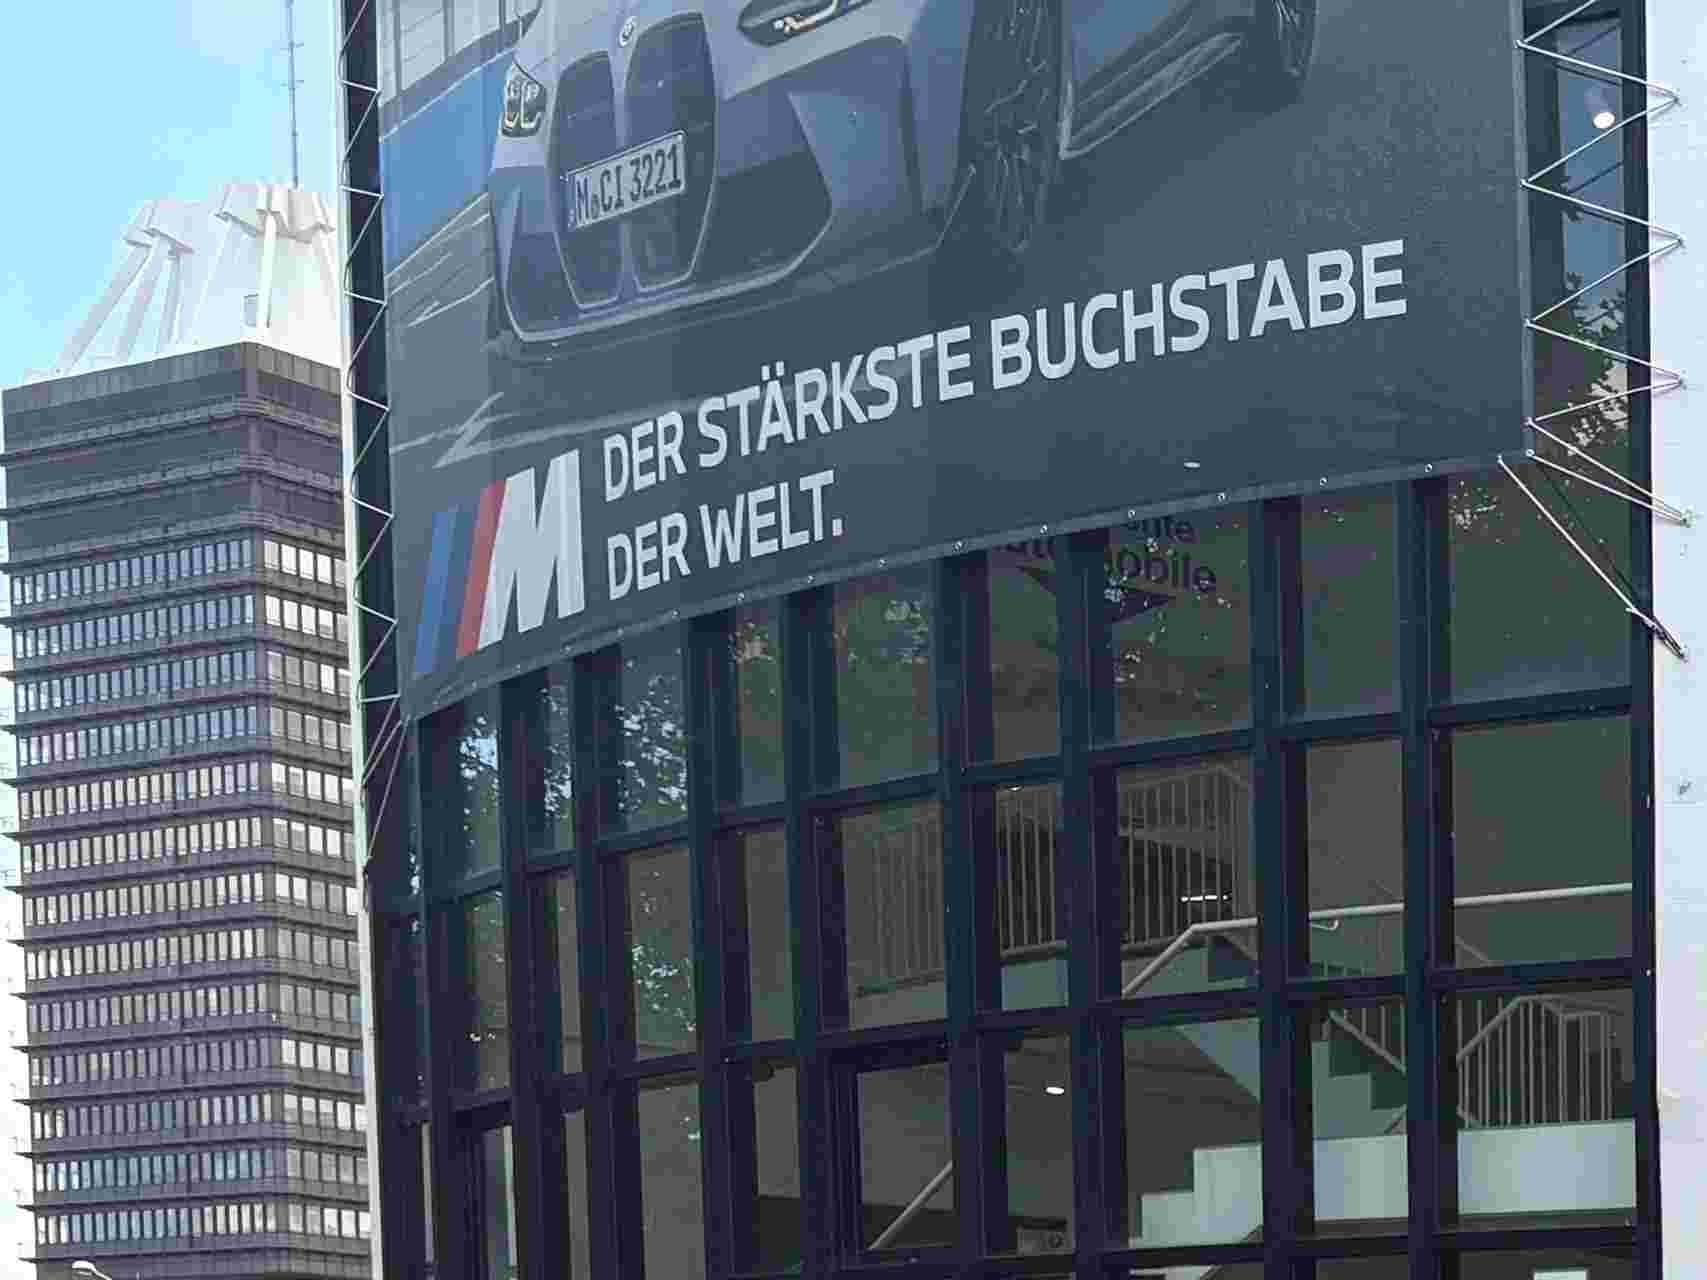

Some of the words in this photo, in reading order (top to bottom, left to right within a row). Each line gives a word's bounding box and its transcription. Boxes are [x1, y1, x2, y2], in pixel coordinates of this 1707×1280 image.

[630, 144, 681, 201] 3221
[603, 411, 688, 503] DER
[699, 326, 974, 468] STÄRKSTE
[990, 239, 1407, 390] BUCHSTABE
[607, 511, 690, 601] DER
[700, 469, 844, 570] WELT.
